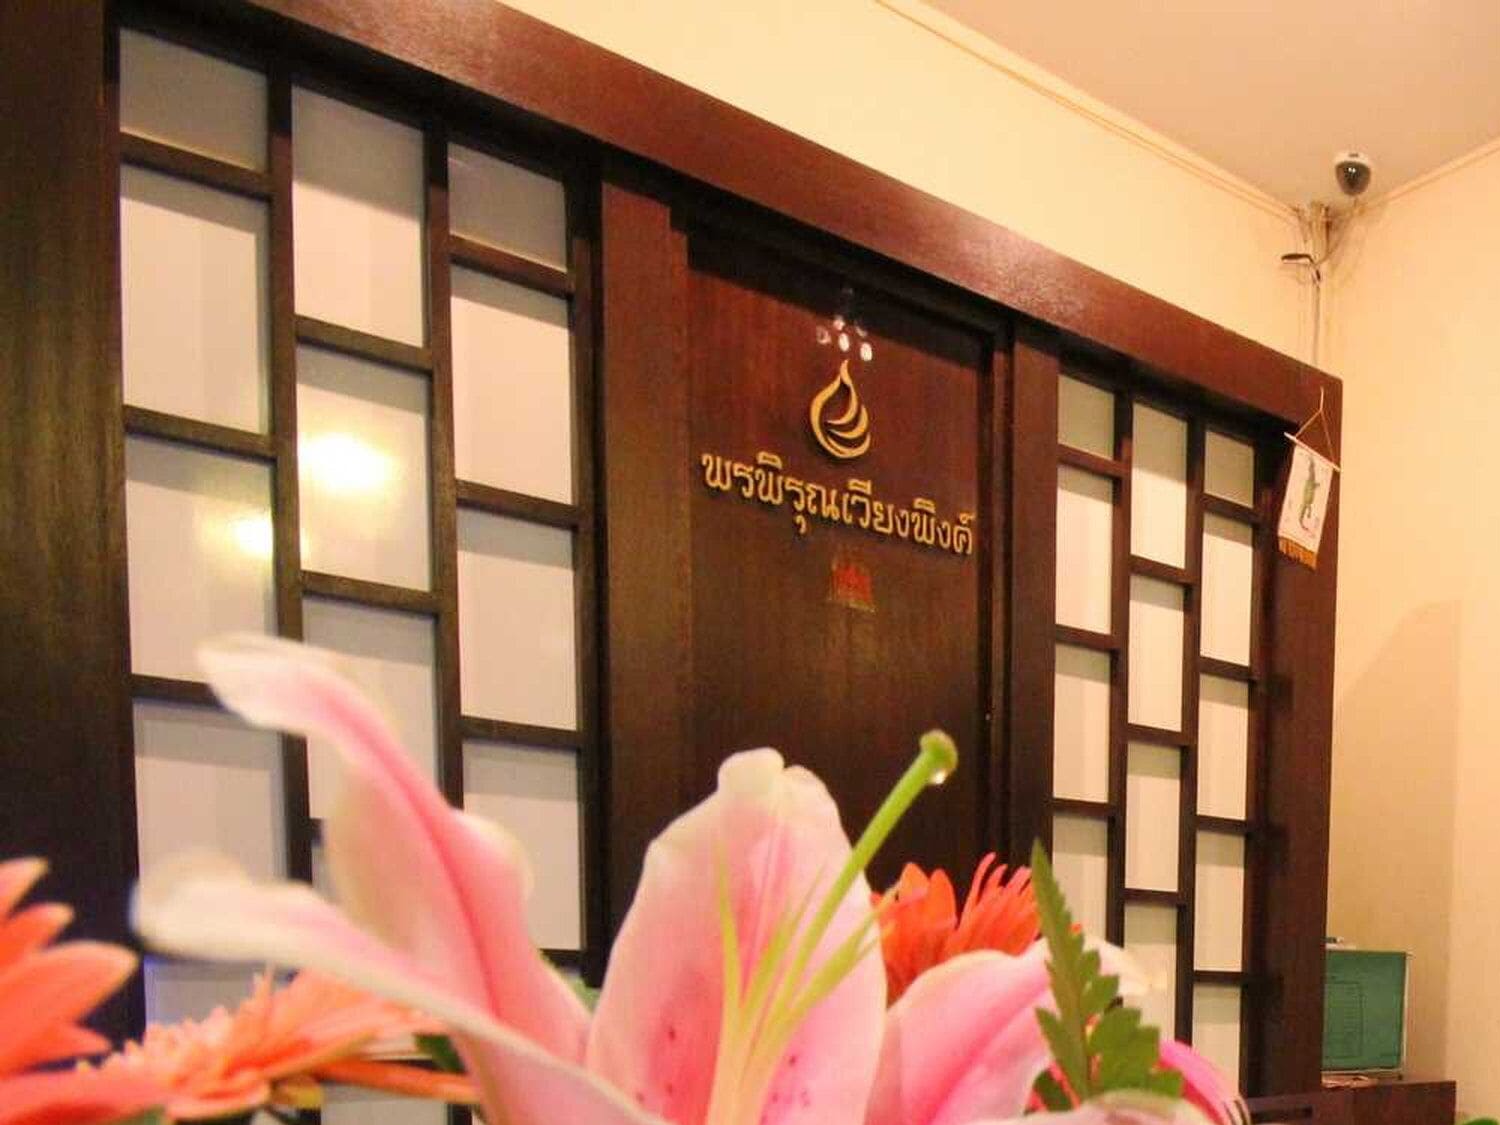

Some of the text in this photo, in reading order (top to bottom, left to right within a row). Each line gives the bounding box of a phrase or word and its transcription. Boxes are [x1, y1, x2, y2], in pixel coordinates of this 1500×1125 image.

[701, 451, 976, 555] พรพิรุณเวียงพิงค์
